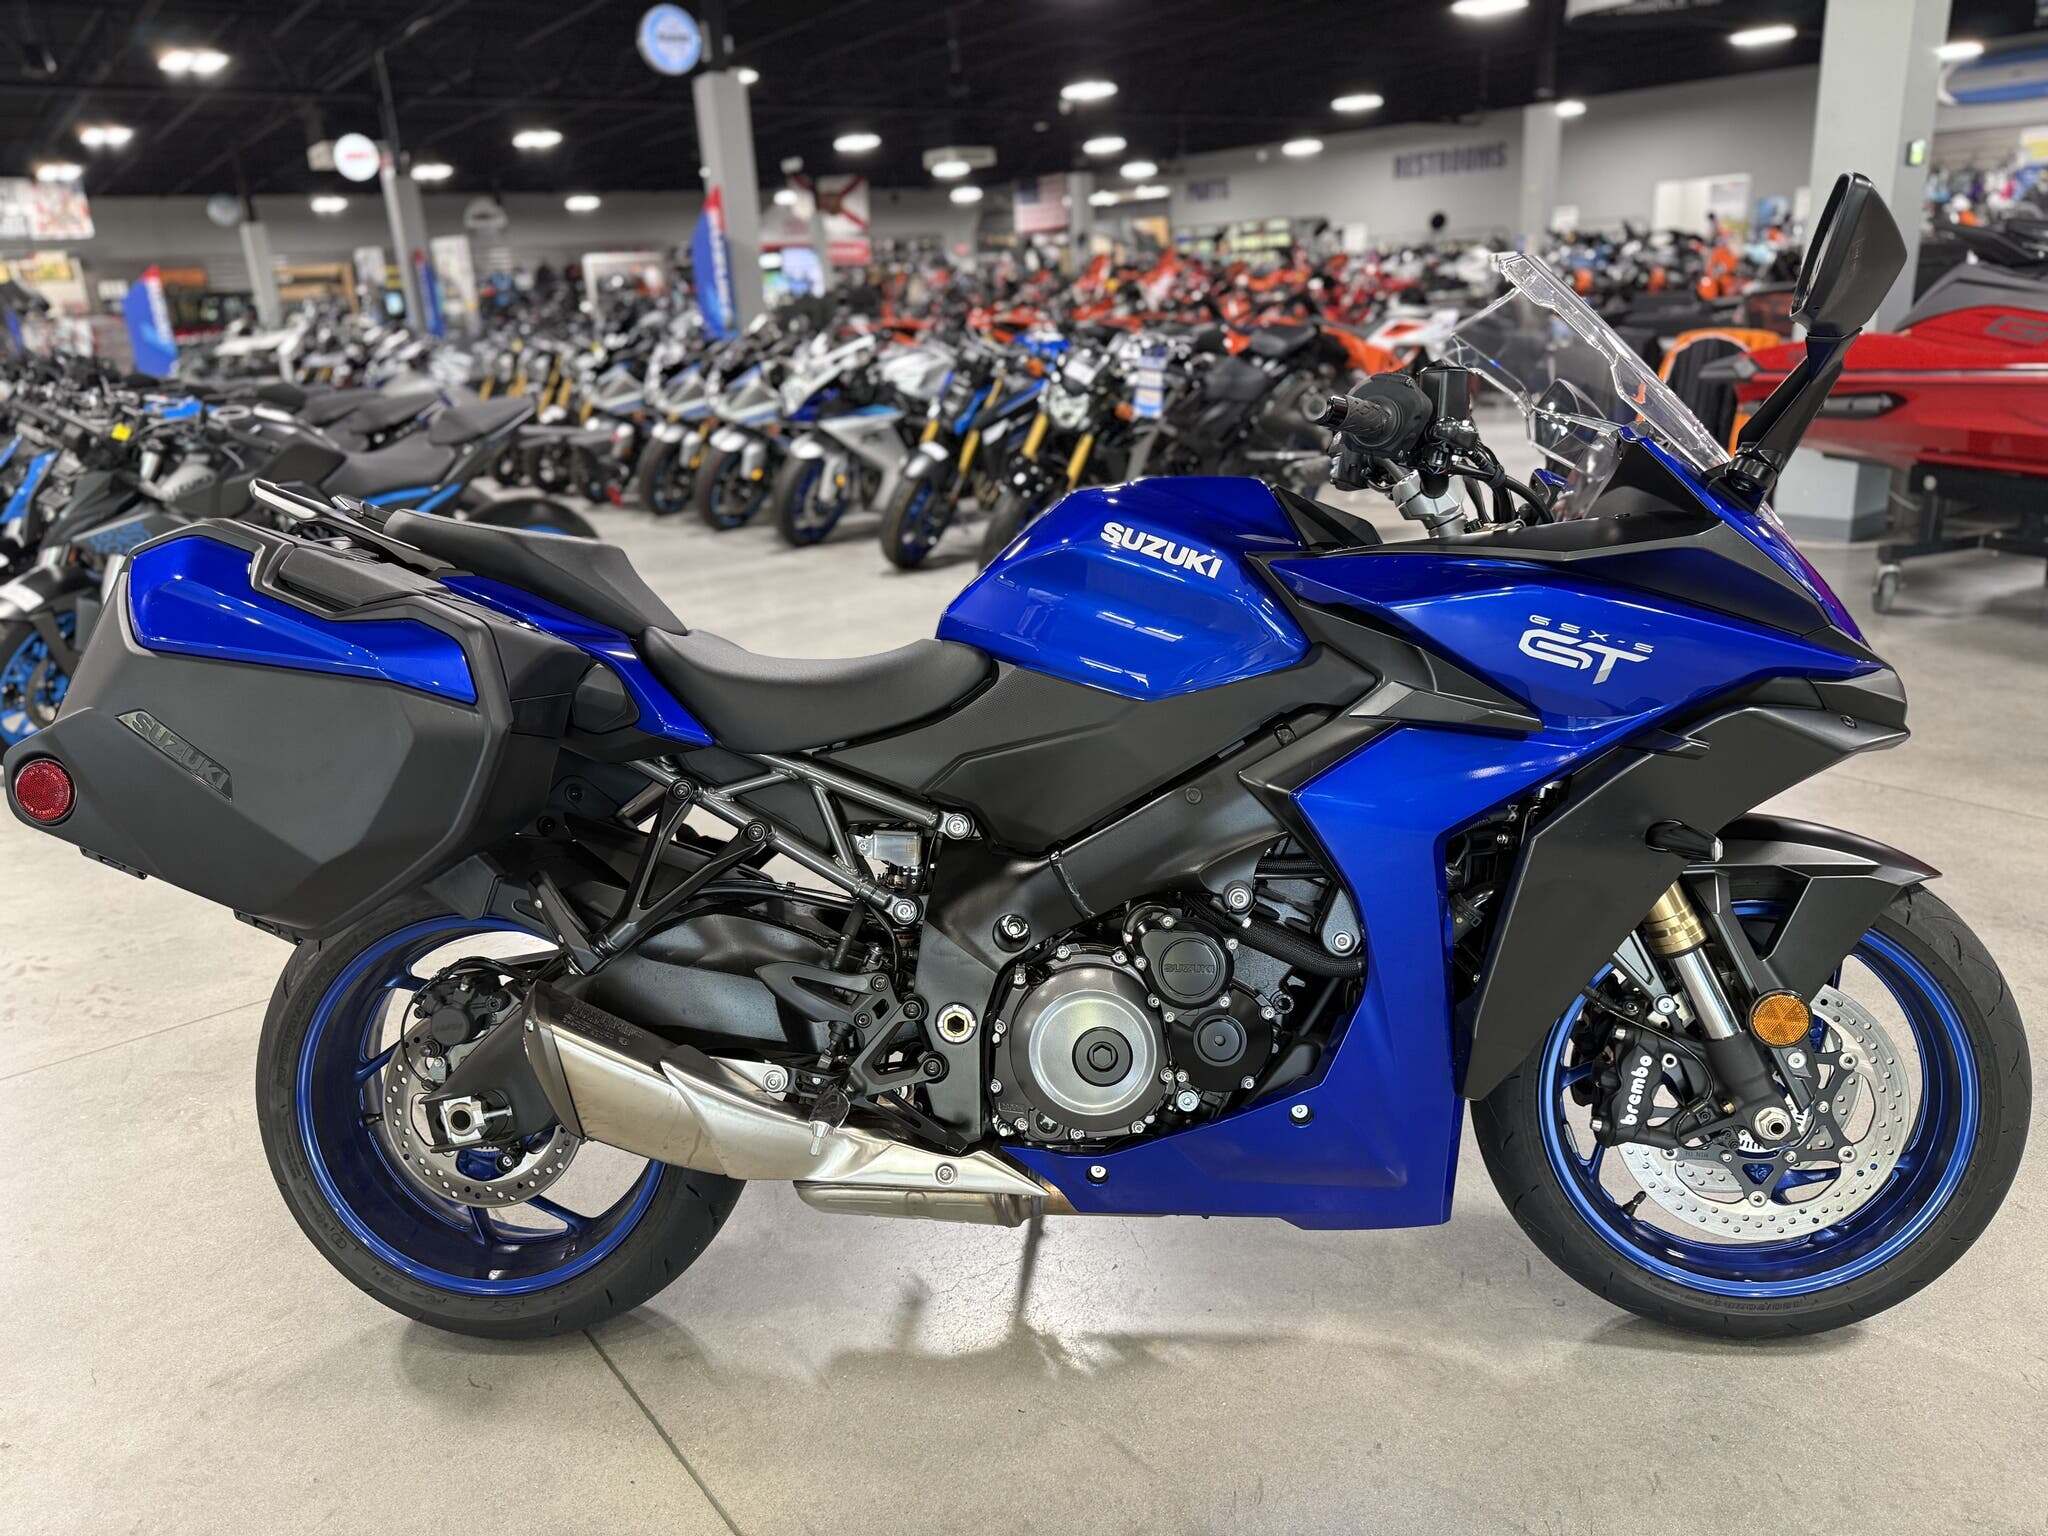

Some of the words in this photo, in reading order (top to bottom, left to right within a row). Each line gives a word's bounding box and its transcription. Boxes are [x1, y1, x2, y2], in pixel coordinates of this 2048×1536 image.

[1100, 522, 1222, 579] SUZUKI
[1518, 629, 1650, 685] GT
[1529, 614, 1654, 653] GSX-S
[132, 712, 230, 790] SUZUKI
[1164, 963, 1216, 974] SUZUKI
[1620, 1055, 1652, 1126] brembo
